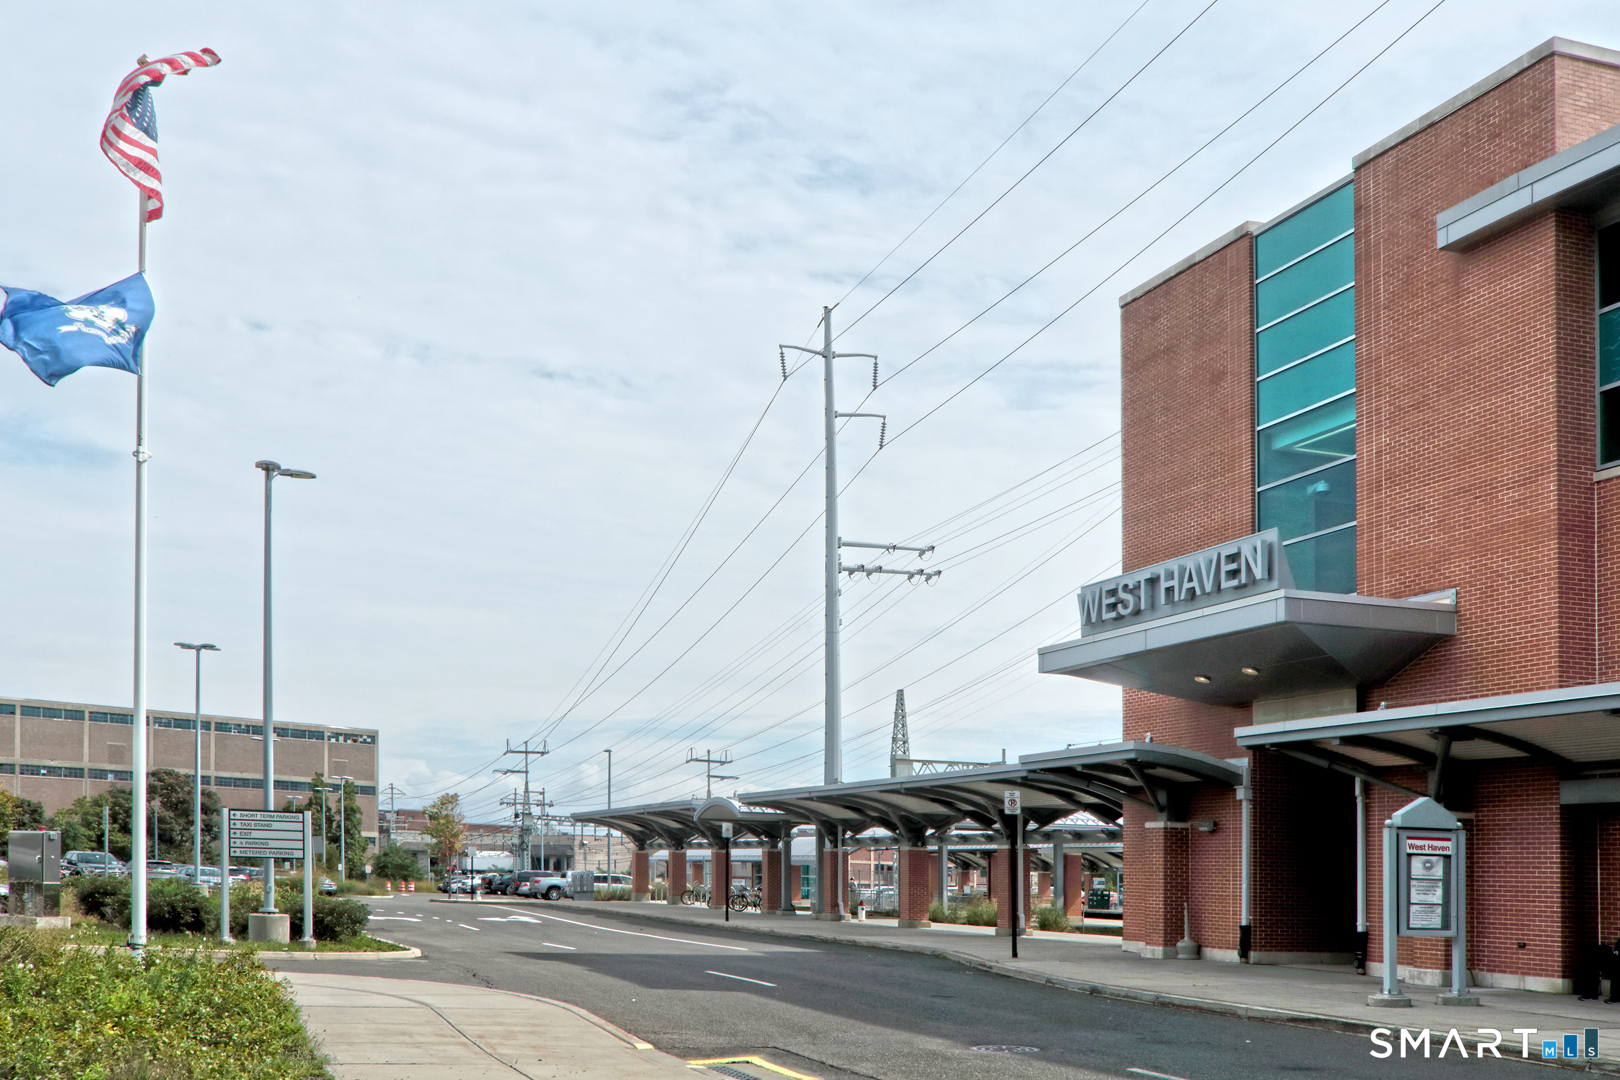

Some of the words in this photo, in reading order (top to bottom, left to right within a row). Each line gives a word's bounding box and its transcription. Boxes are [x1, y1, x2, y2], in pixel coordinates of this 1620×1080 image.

[1077, 572, 1158, 626] WEST
[1160, 539, 1269, 605] HAVEN
[1408, 843, 1426, 851] West
